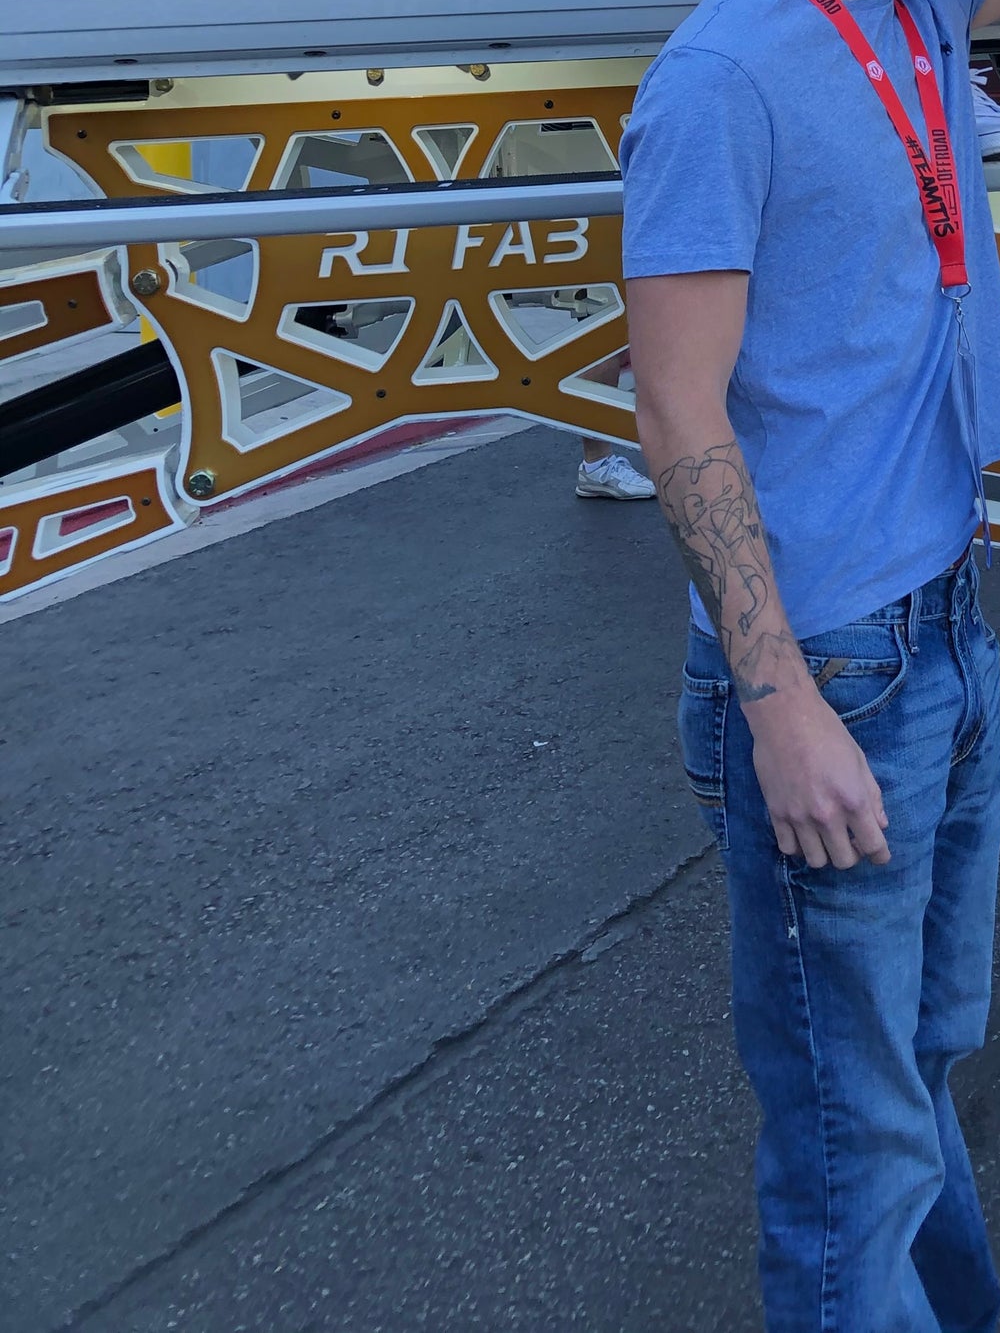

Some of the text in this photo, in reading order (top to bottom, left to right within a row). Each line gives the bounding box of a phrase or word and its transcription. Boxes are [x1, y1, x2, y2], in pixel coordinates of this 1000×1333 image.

[931, 129, 953, 181] OFFROAD
[904, 134, 955, 238] #TEAMTIS
[451, 217, 588, 270] FAB
